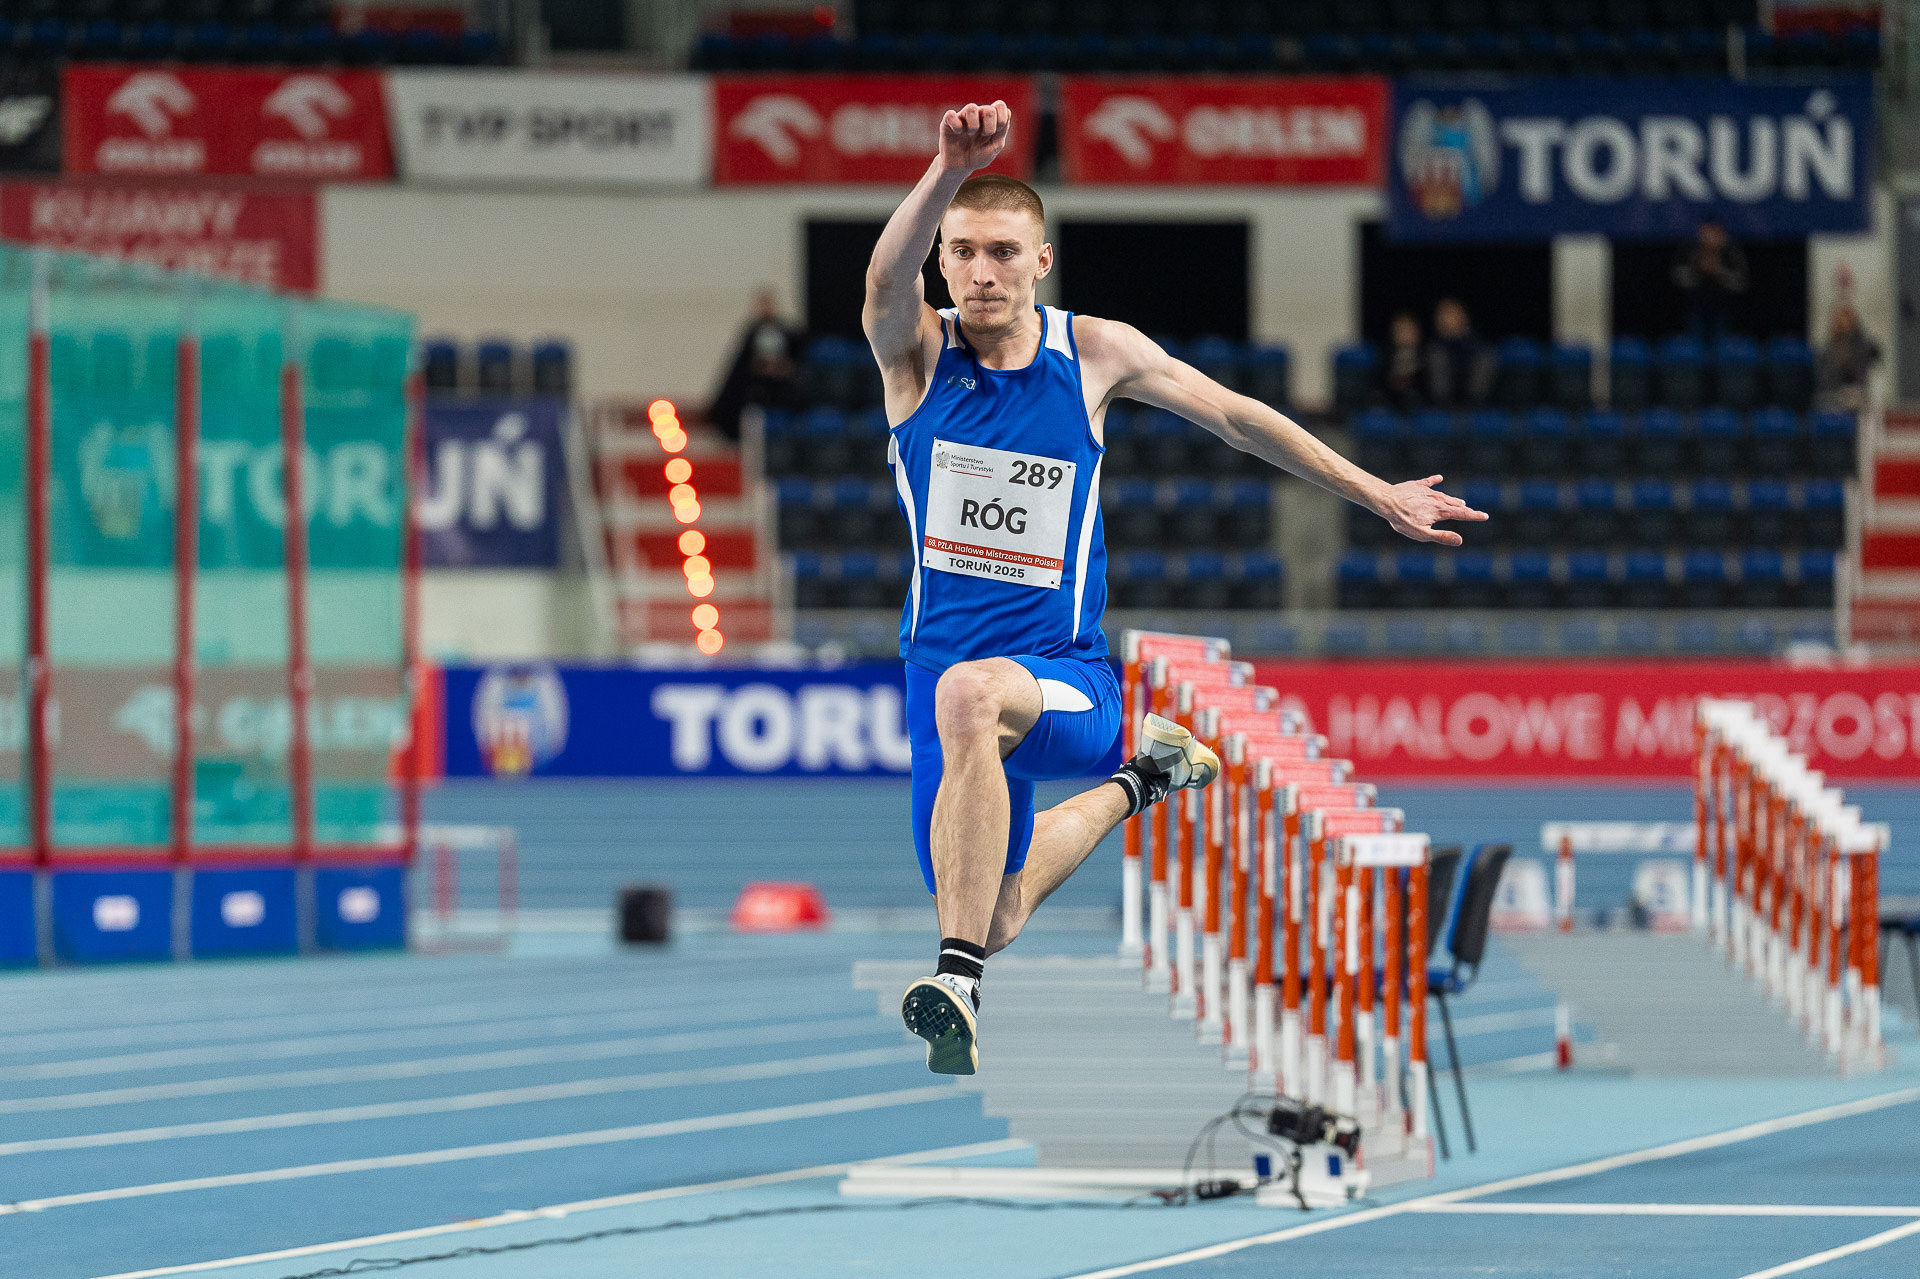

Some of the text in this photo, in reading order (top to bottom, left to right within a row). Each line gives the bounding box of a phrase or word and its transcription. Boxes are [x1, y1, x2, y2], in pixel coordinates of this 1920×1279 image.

[528, 107, 676, 151] SPORT
[1180, 104, 1368, 155] ORLEN
[1502, 89, 1855, 202] TORUŃ
[950, 460, 966, 469] Sportu
[970, 463, 994, 473] Turystyki
[951, 454, 984, 465] Ministerstwa
[1008, 460, 1064, 490] 289
[960, 498, 1028, 535] RÓG
[937, 541, 953, 551] PZLA
[954, 544, 985, 556] Halowe
[985, 549, 1033, 564] Mistrzostwa
[1033, 556, 1058, 568] Polski
[949, 557, 1025, 578] TORUŃ 2025
[1327, 692, 1604, 760] HALOWE
